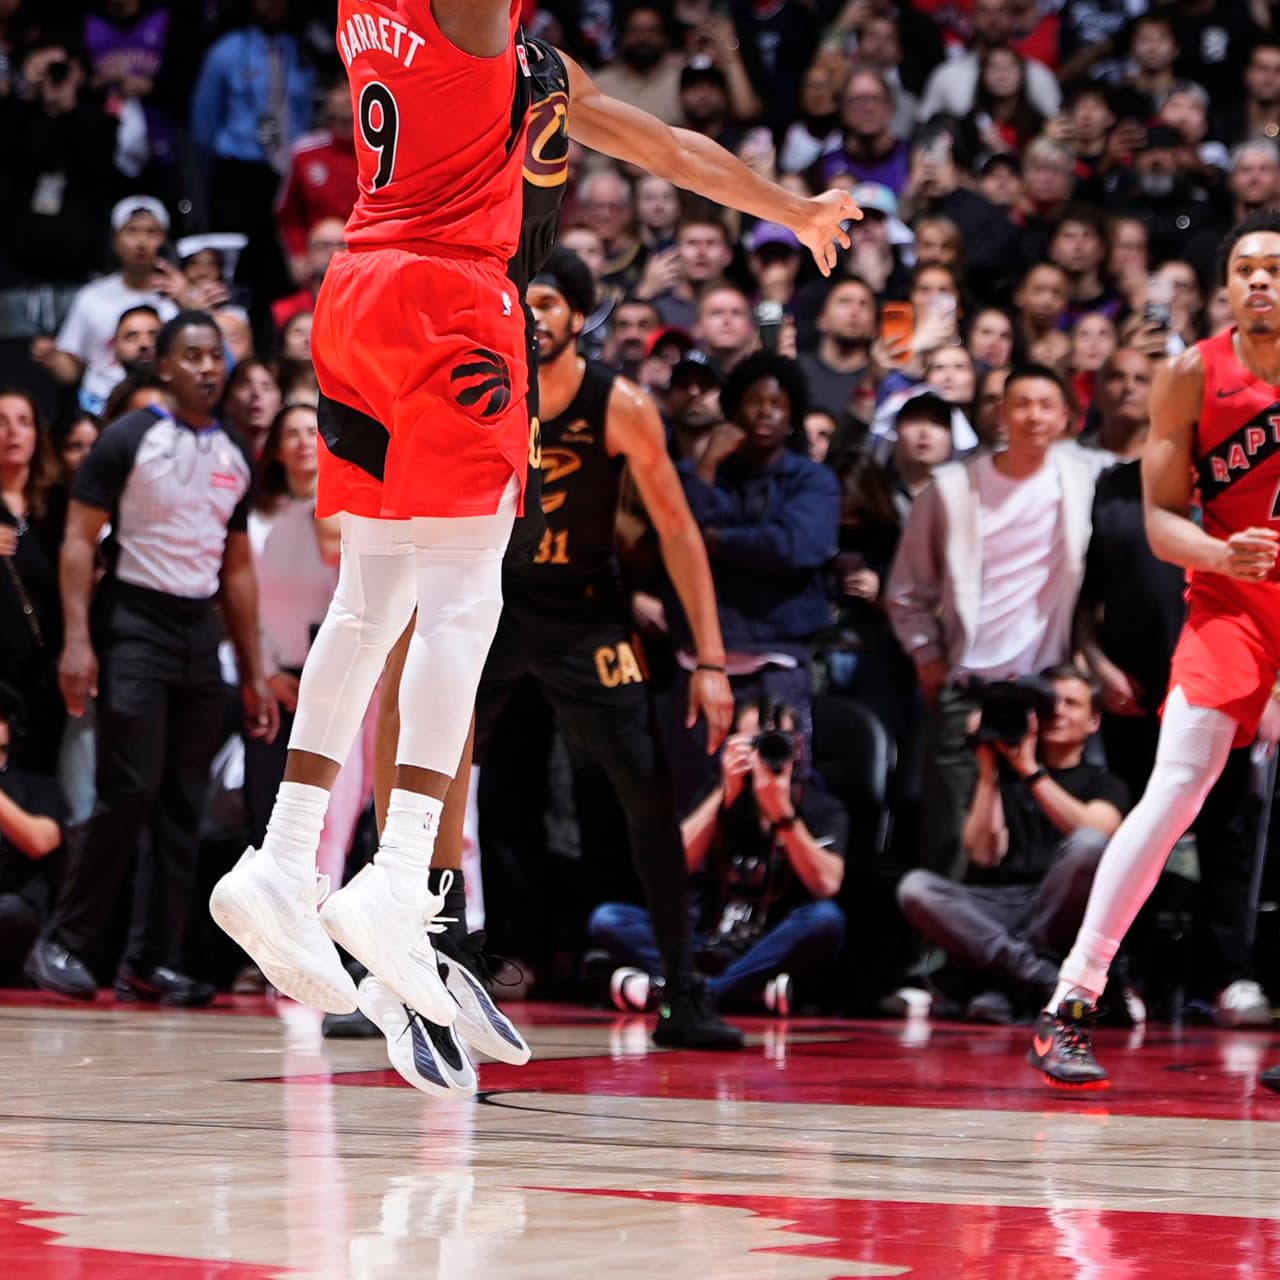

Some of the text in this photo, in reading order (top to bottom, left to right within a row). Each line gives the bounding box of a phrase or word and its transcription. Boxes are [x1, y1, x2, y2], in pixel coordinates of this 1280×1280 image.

[339, 13, 426, 68] BARRETT
[358, 81, 399, 193] 9
[594, 641, 643, 688] CA
